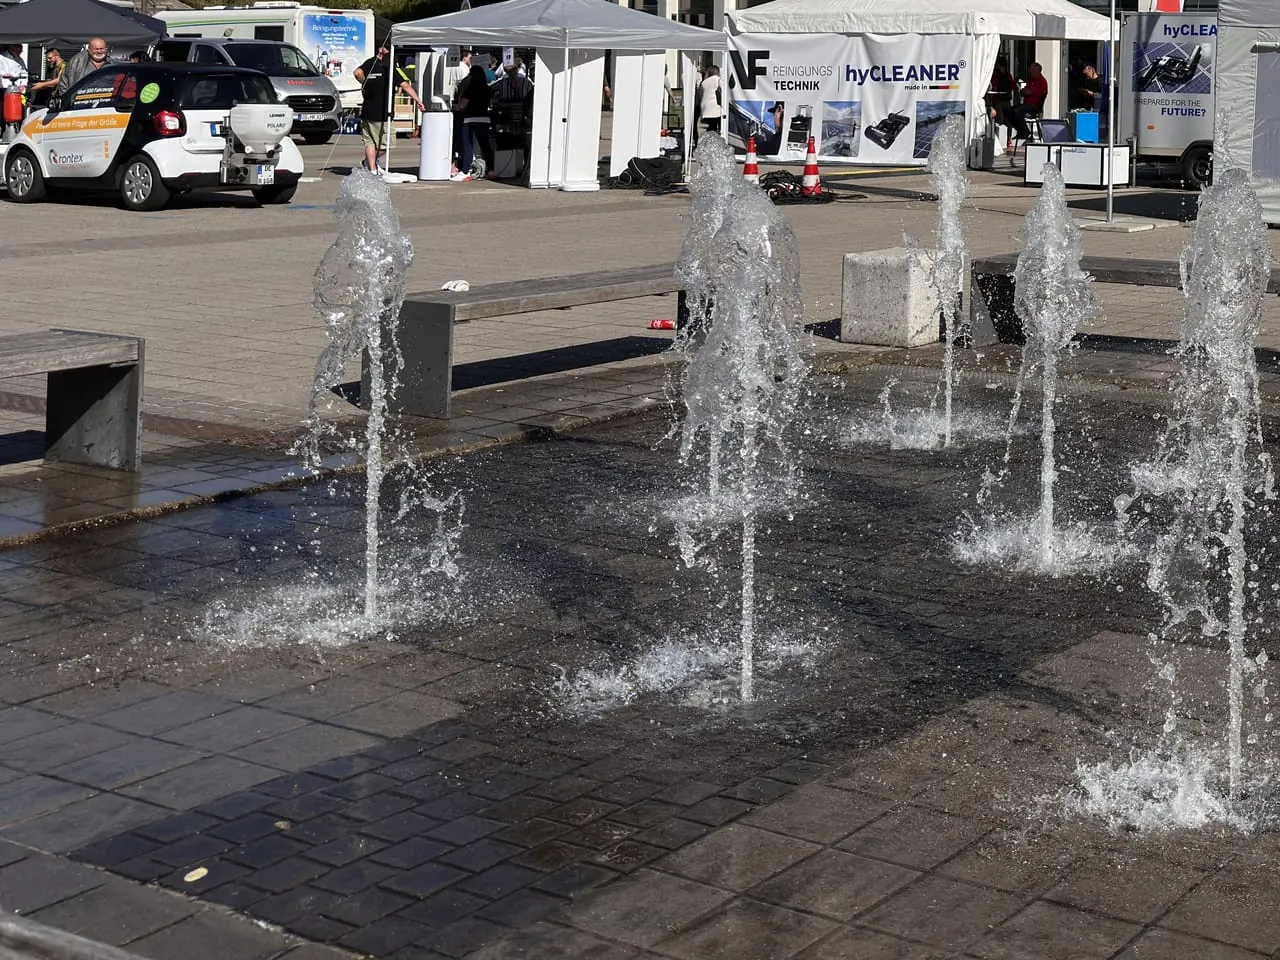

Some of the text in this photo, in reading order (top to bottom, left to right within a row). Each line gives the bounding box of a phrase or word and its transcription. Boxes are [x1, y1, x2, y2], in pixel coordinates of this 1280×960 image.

[1163, 24, 1217, 38] hyCLEA
[772, 65, 833, 77] REINIGUNGS
[773, 80, 820, 91] TECHNIK
[1134, 98, 1170, 106] PREPARED
[1161, 107, 1206, 117] FUTURE?
